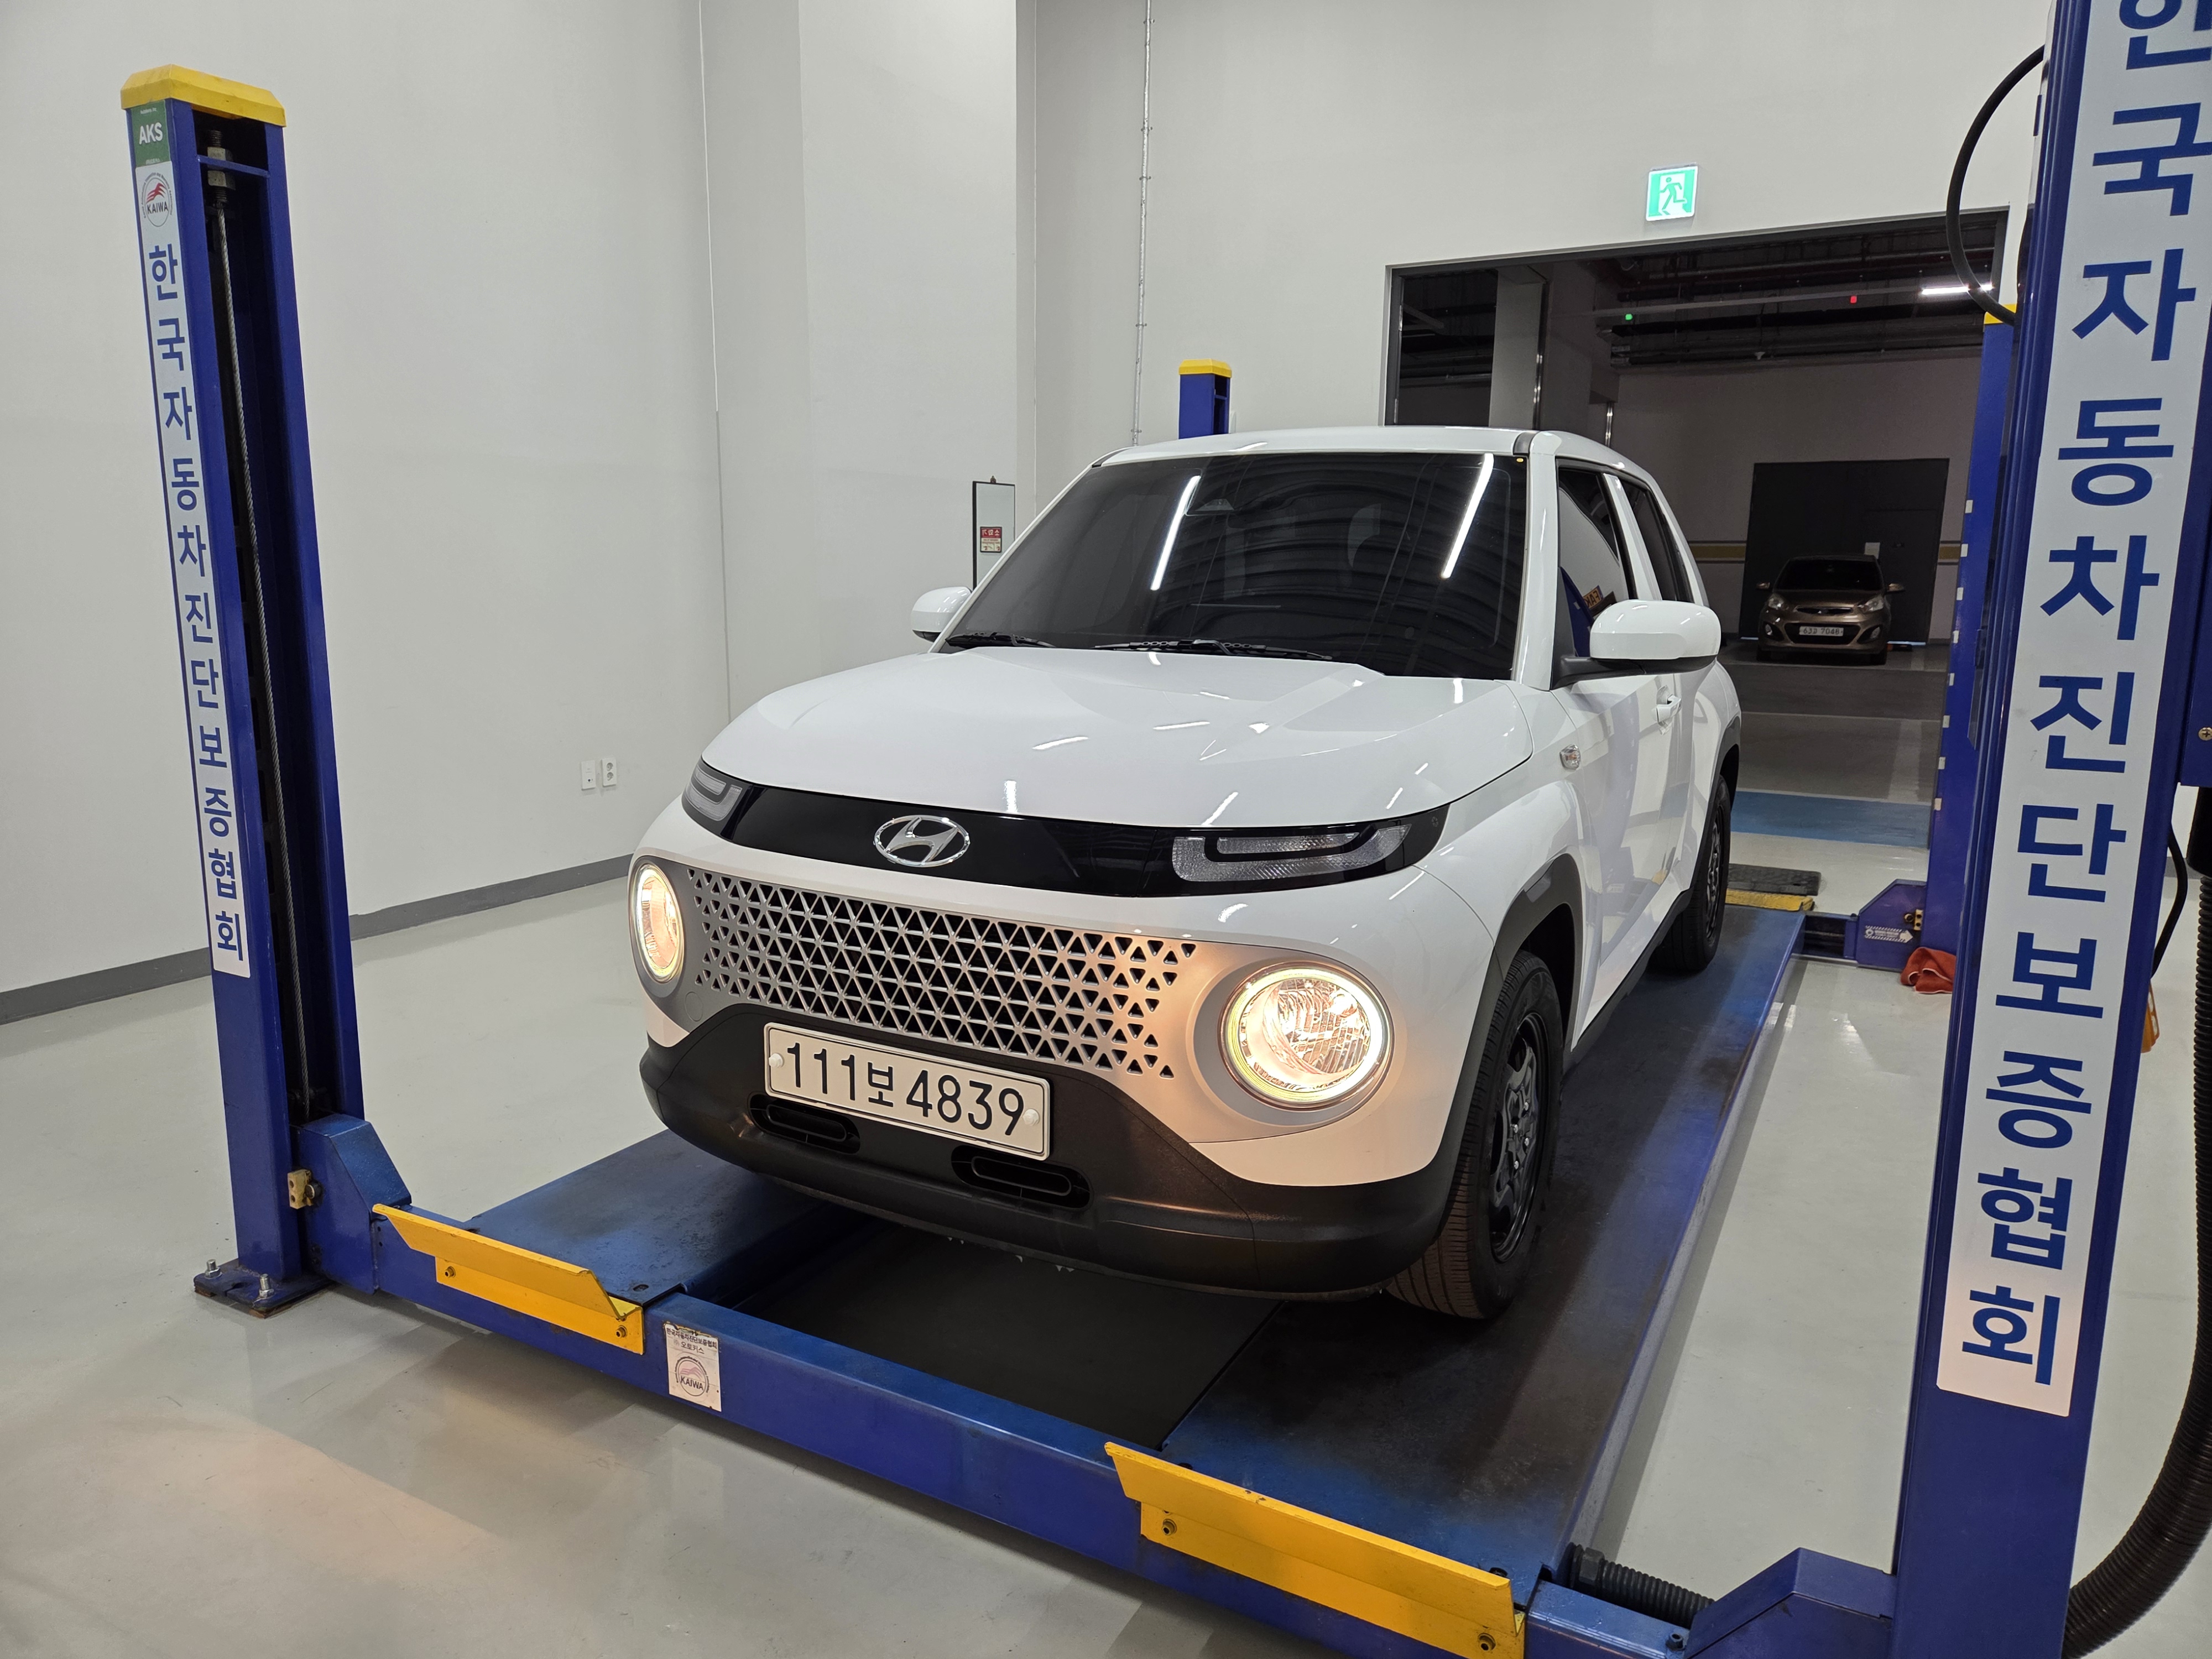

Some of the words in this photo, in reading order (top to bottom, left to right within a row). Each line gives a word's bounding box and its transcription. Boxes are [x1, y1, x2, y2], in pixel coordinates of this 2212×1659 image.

[139, 122, 163, 145] AKS
[147, 201, 169, 215] KAIWA
[149, 243, 243, 962] 한국자동차진단보증협회
[787, 1042, 1024, 1136] 111보4839
[681, 1375, 704, 1391] KAIWA
